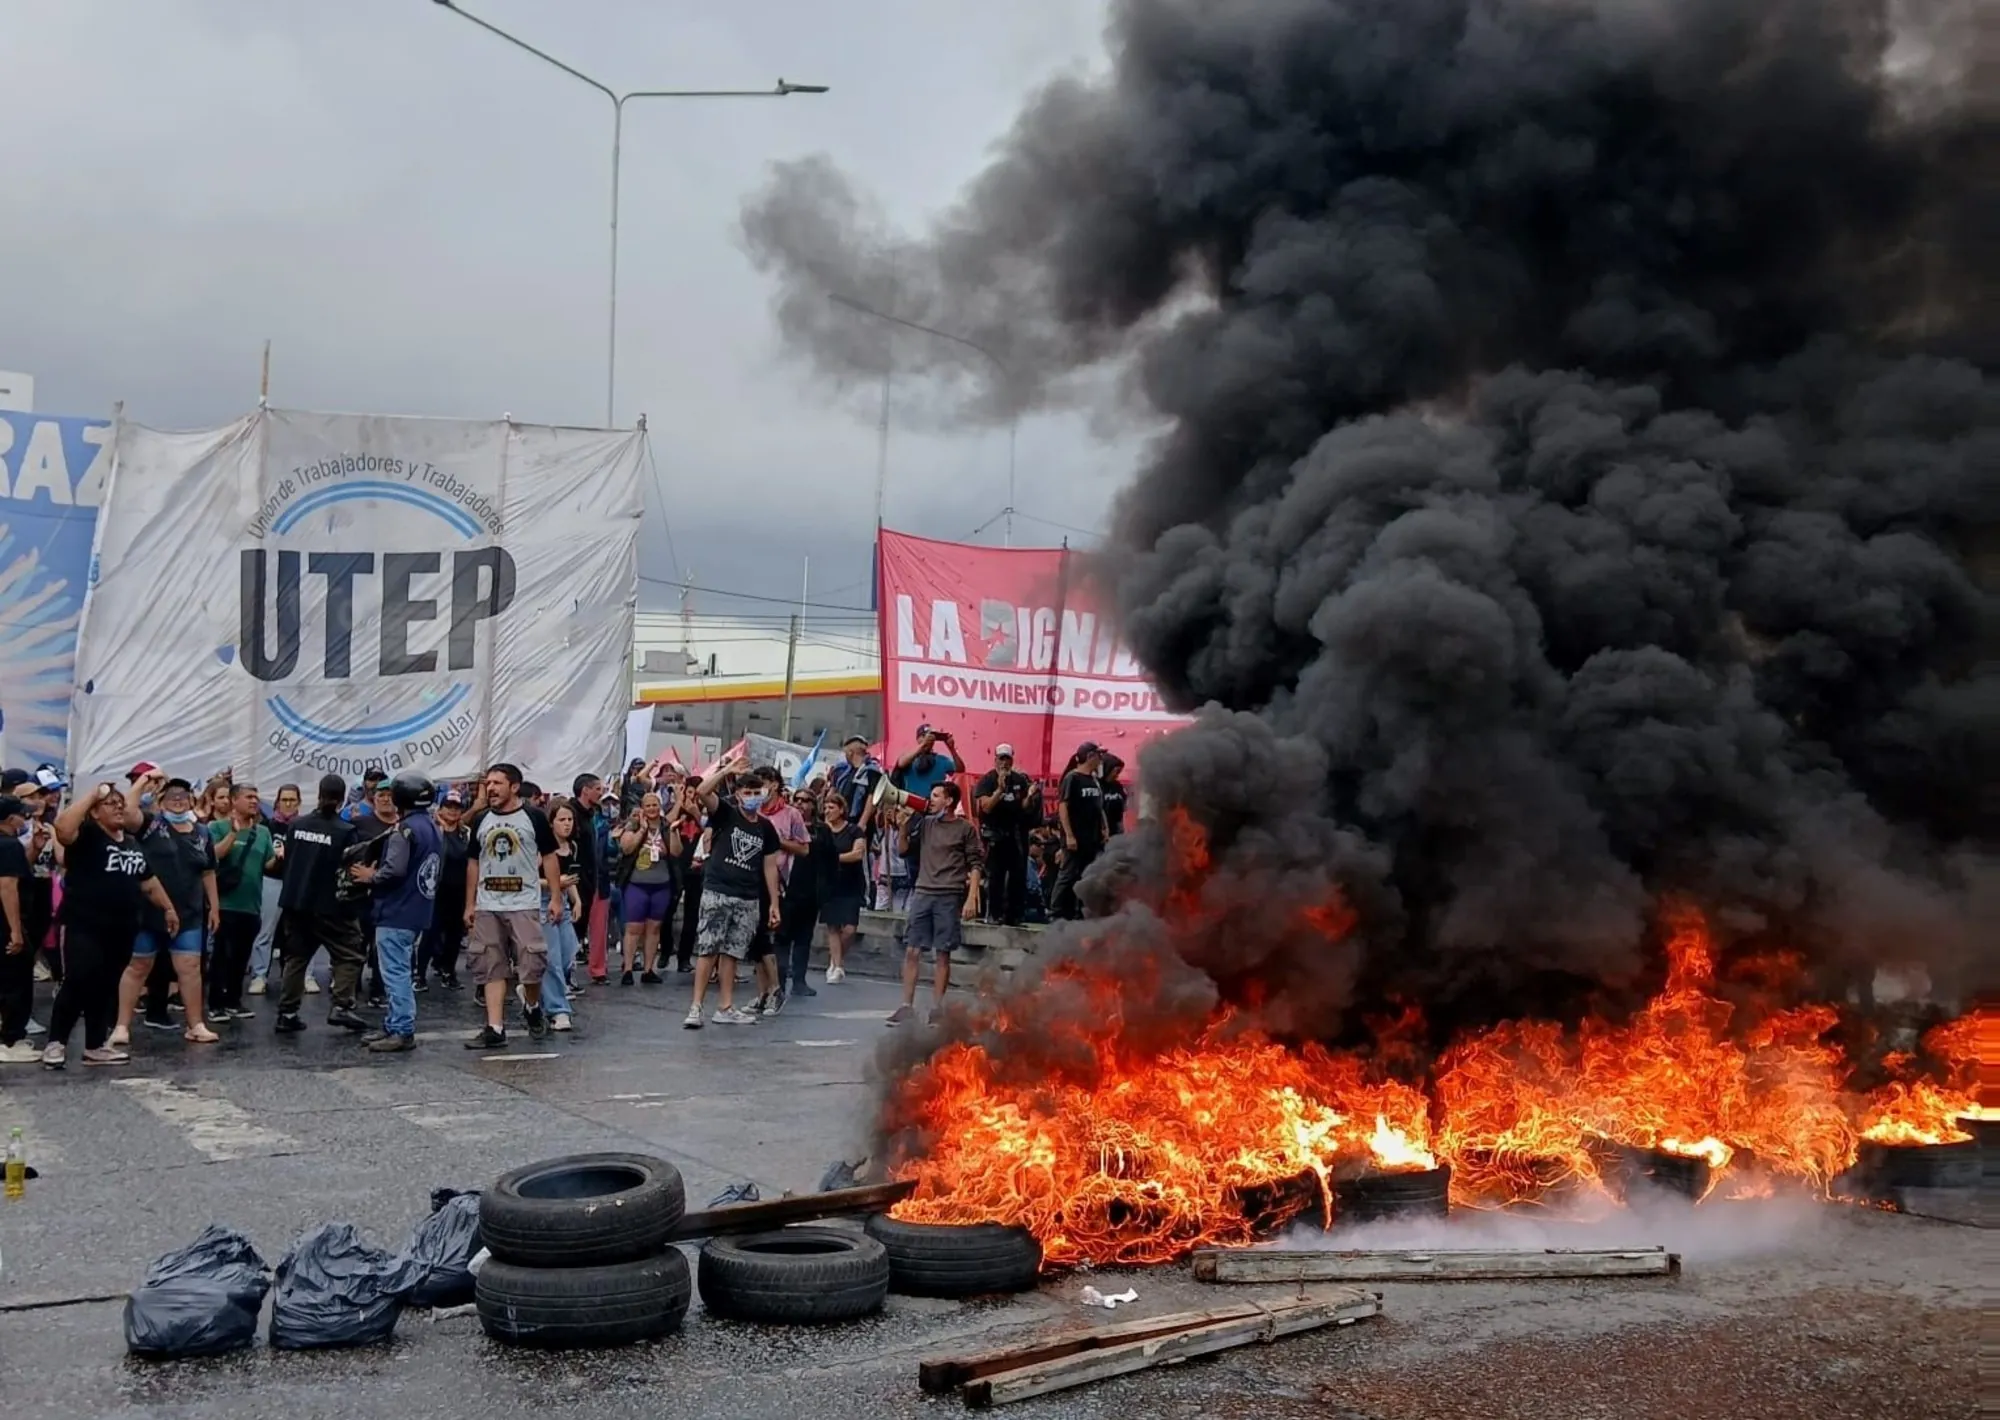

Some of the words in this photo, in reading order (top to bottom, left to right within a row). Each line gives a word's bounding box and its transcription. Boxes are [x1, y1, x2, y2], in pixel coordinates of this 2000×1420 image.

[0, 417, 112, 507] AZ
[247, 496, 281, 540] Unión
[278, 479, 296, 500] de
[292, 452, 404, 486] Trabajadores
[407, 462, 419, 481] y
[421, 462, 505, 537] Trabajadoras
[239, 546, 517, 681] UTEP
[897, 594, 967, 664] LA
[981, 598, 1141, 676] DIGNI
[910, 672, 1065, 707] MOVIMIENTO
[269, 729, 290, 752] de
[290, 740, 306, 763] la
[307, 747, 403, 776] Economía
[405, 708, 476, 763] Popular
[294, 830, 332, 846] PRENSA
